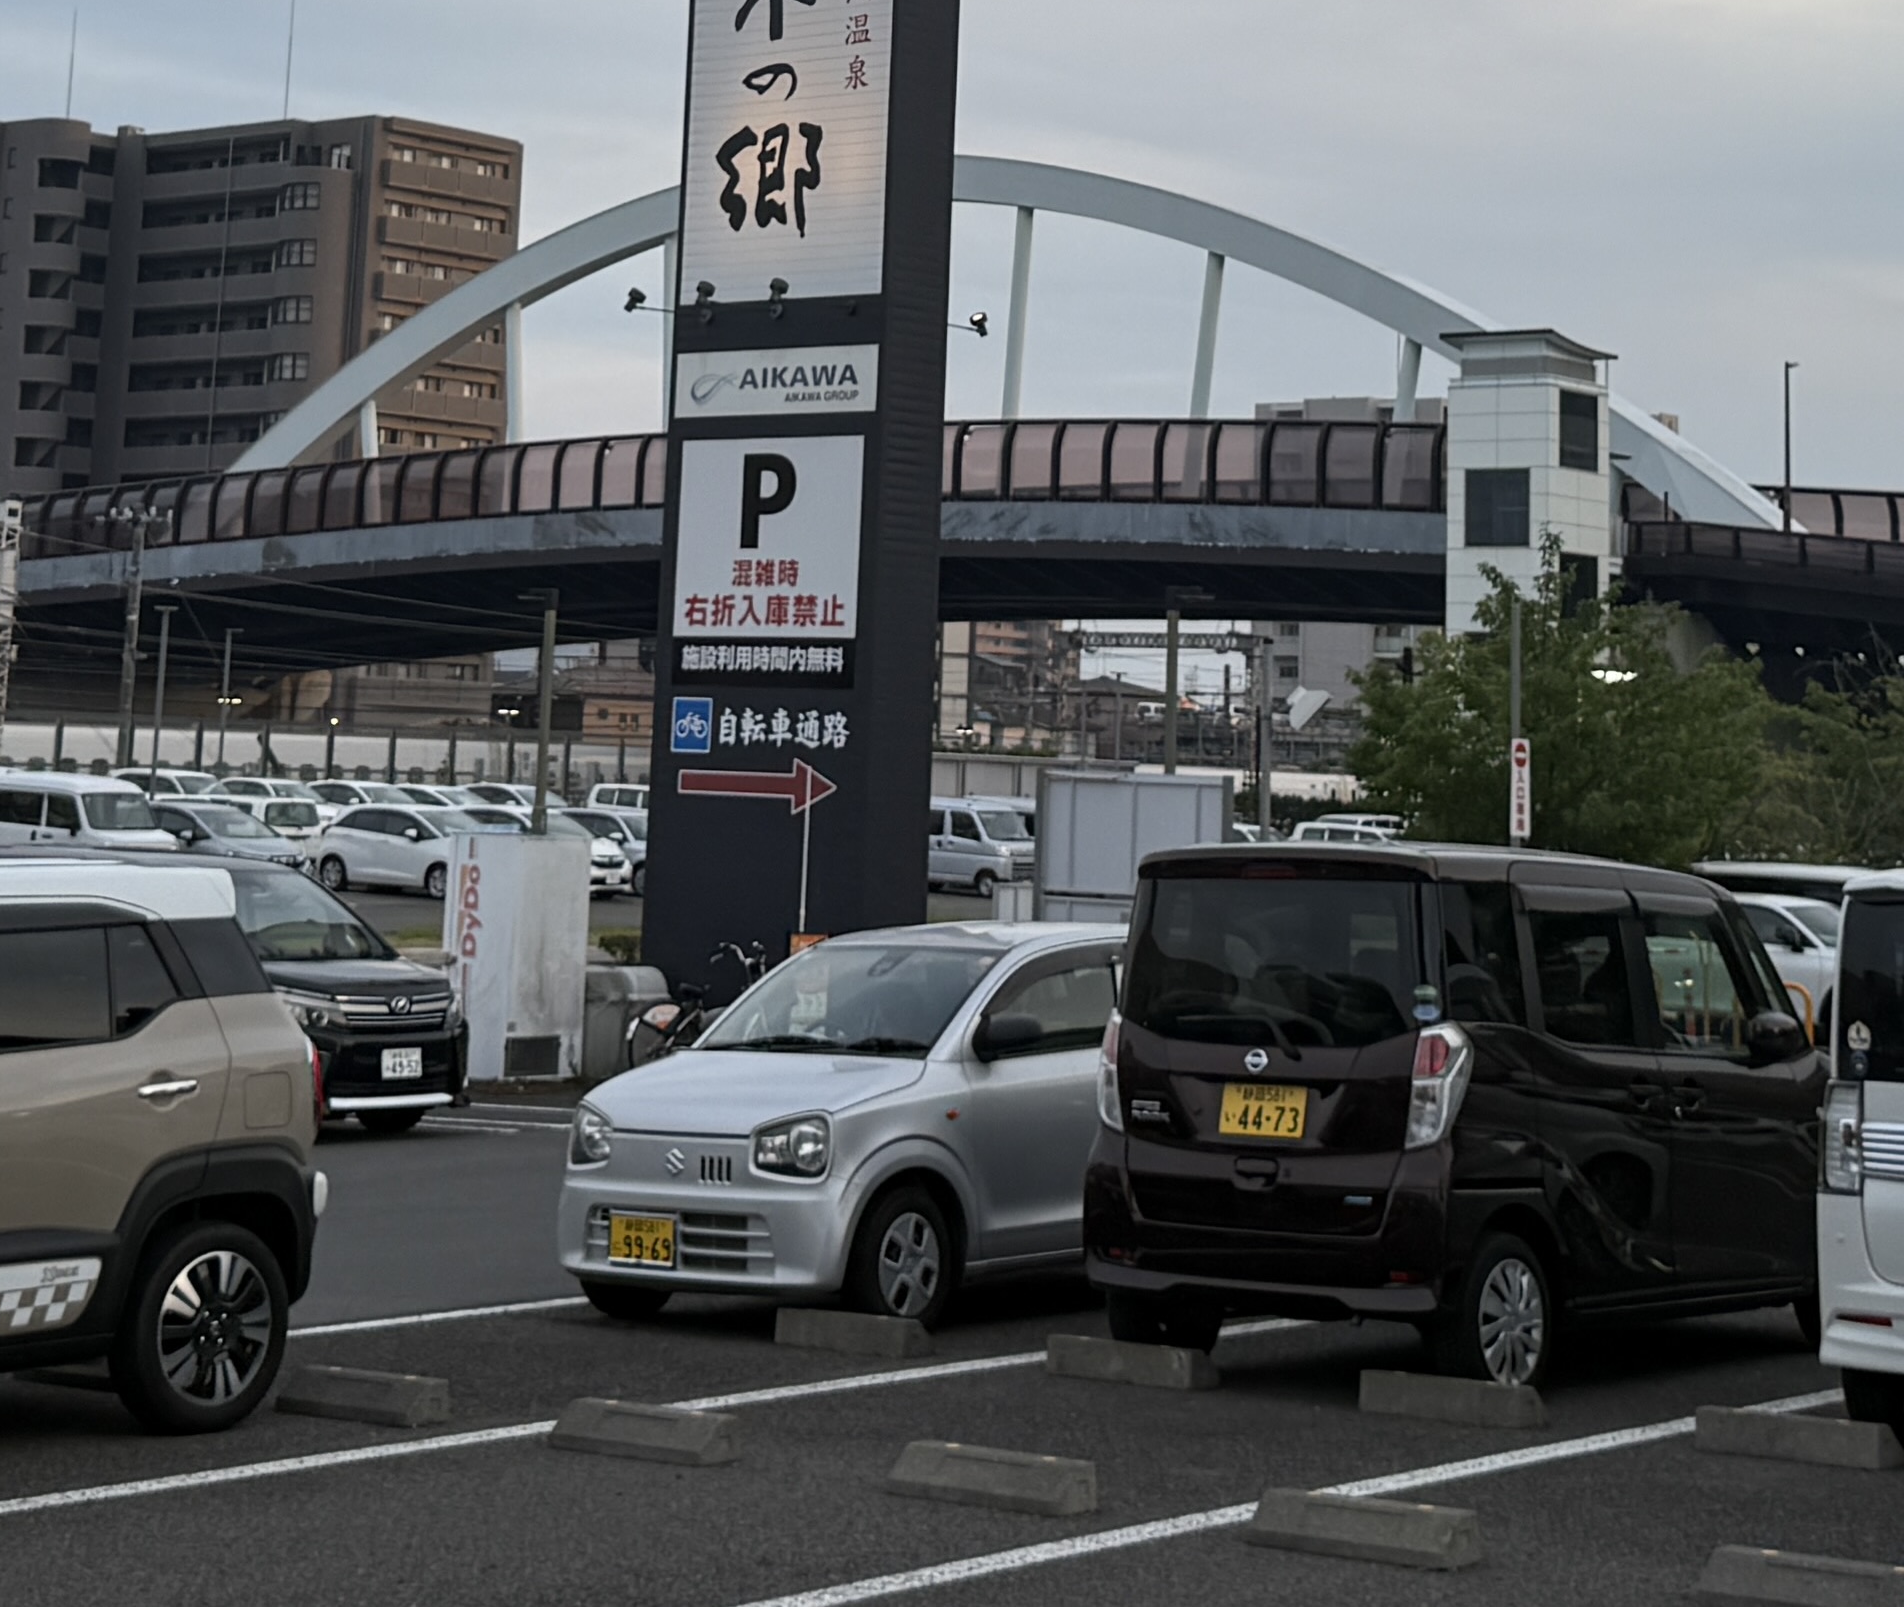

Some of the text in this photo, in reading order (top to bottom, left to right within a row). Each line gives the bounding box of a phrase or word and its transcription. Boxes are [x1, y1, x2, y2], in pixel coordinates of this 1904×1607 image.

[739, 364, 859, 389] AIKAWA
[784, 390, 859, 403] AIKAWA GROUP
[739, 453, 797, 549] P
[732, 559, 800, 587] 混雑時
[684, 594, 845, 627] 右折入庫禁止
[681, 645, 844, 673] 施設利用時間内無料
[718, 707, 850, 750] 自転車通路
[462, 865, 483, 958] DyDo
[623, 1234, 671, 1261] 99-69
